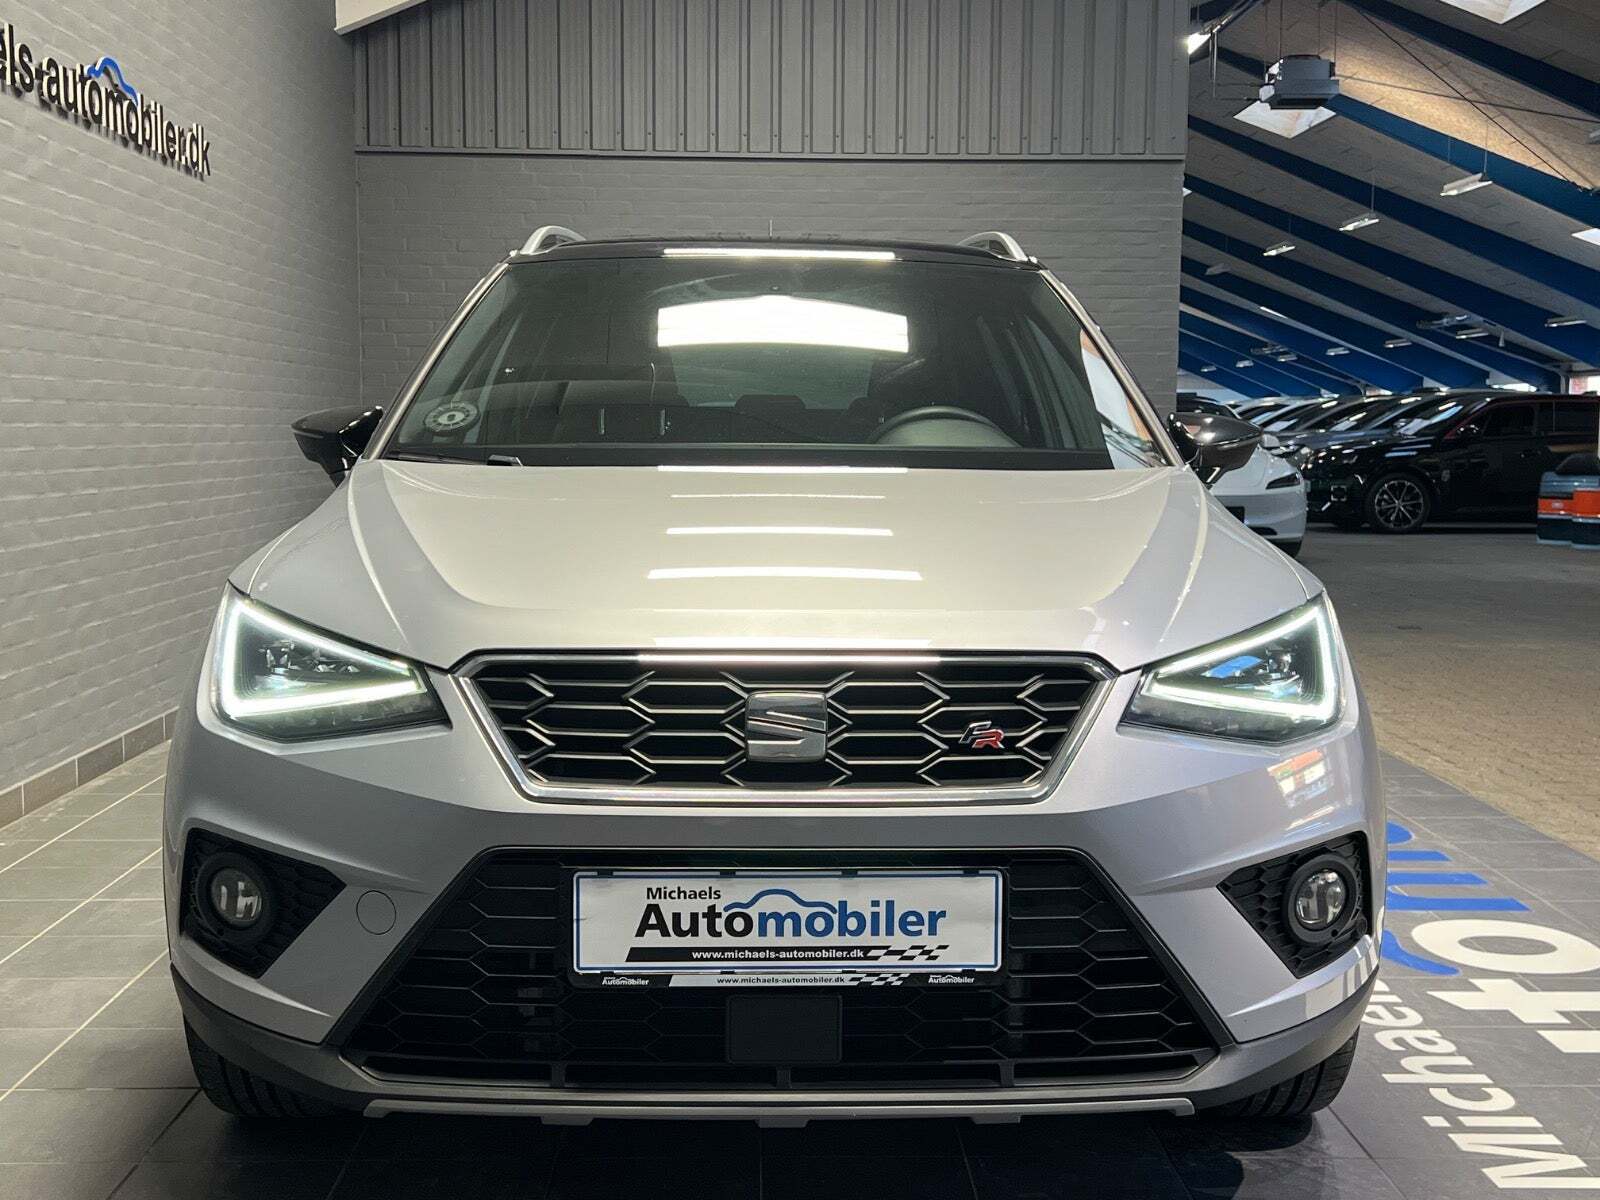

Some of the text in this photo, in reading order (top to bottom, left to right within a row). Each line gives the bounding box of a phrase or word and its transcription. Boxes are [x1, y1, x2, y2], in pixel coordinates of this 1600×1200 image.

[958, 720, 1005, 748] FR
[646, 886, 722, 900] Michaels
[635, 900, 947, 937] Automobiler
[692, 949, 865, 959] www.michaels-automobiler.dk
[716, 976, 845, 985] www.michaels-automobiler.dk
[1361, 979, 1600, 1189] Michae
